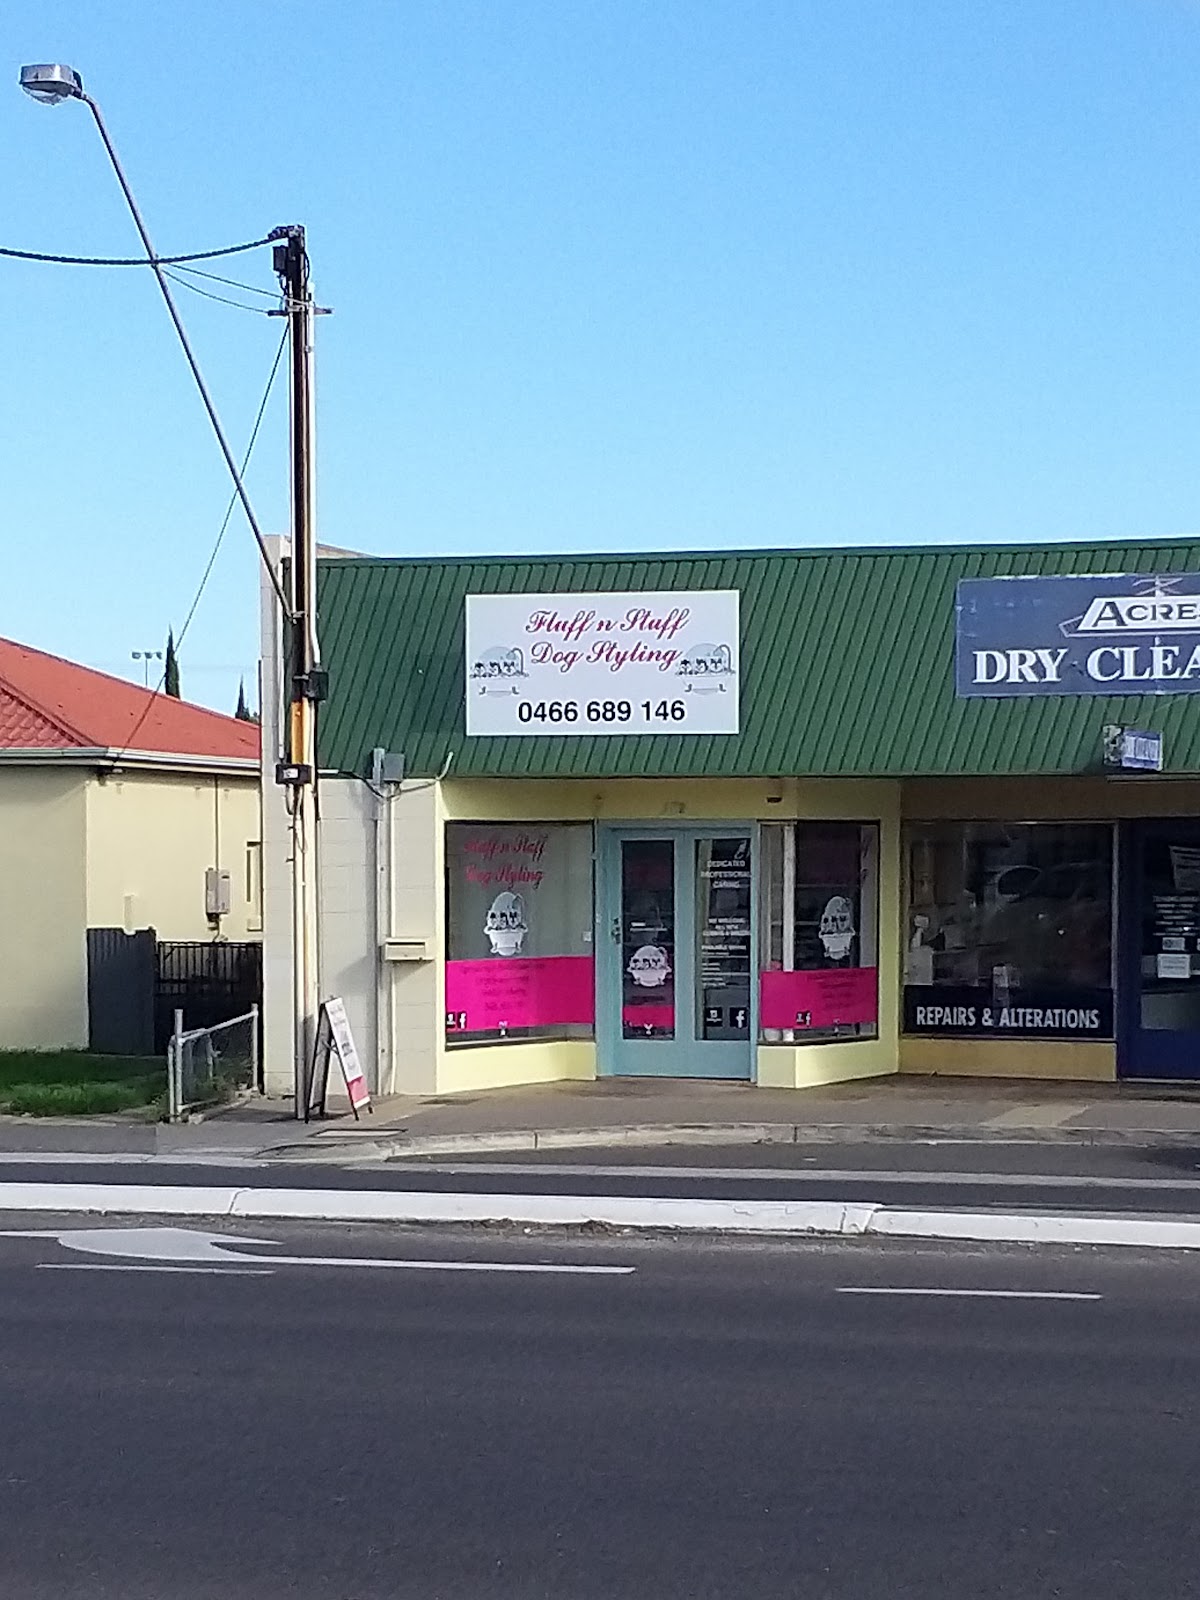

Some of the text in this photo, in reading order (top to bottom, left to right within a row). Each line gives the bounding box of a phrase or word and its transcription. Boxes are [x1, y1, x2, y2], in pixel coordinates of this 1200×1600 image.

[525, 608, 690, 641] Fluff n Stuff
[1092, 601, 1200, 627] ACRE
[530, 640, 683, 673] Dog Styling
[972, 645, 1200, 684] DRY CLEA
[518, 700, 686, 723] 0466 689 146
[916, 1006, 1100, 1029] REPAIRS & ALTERATIONS
